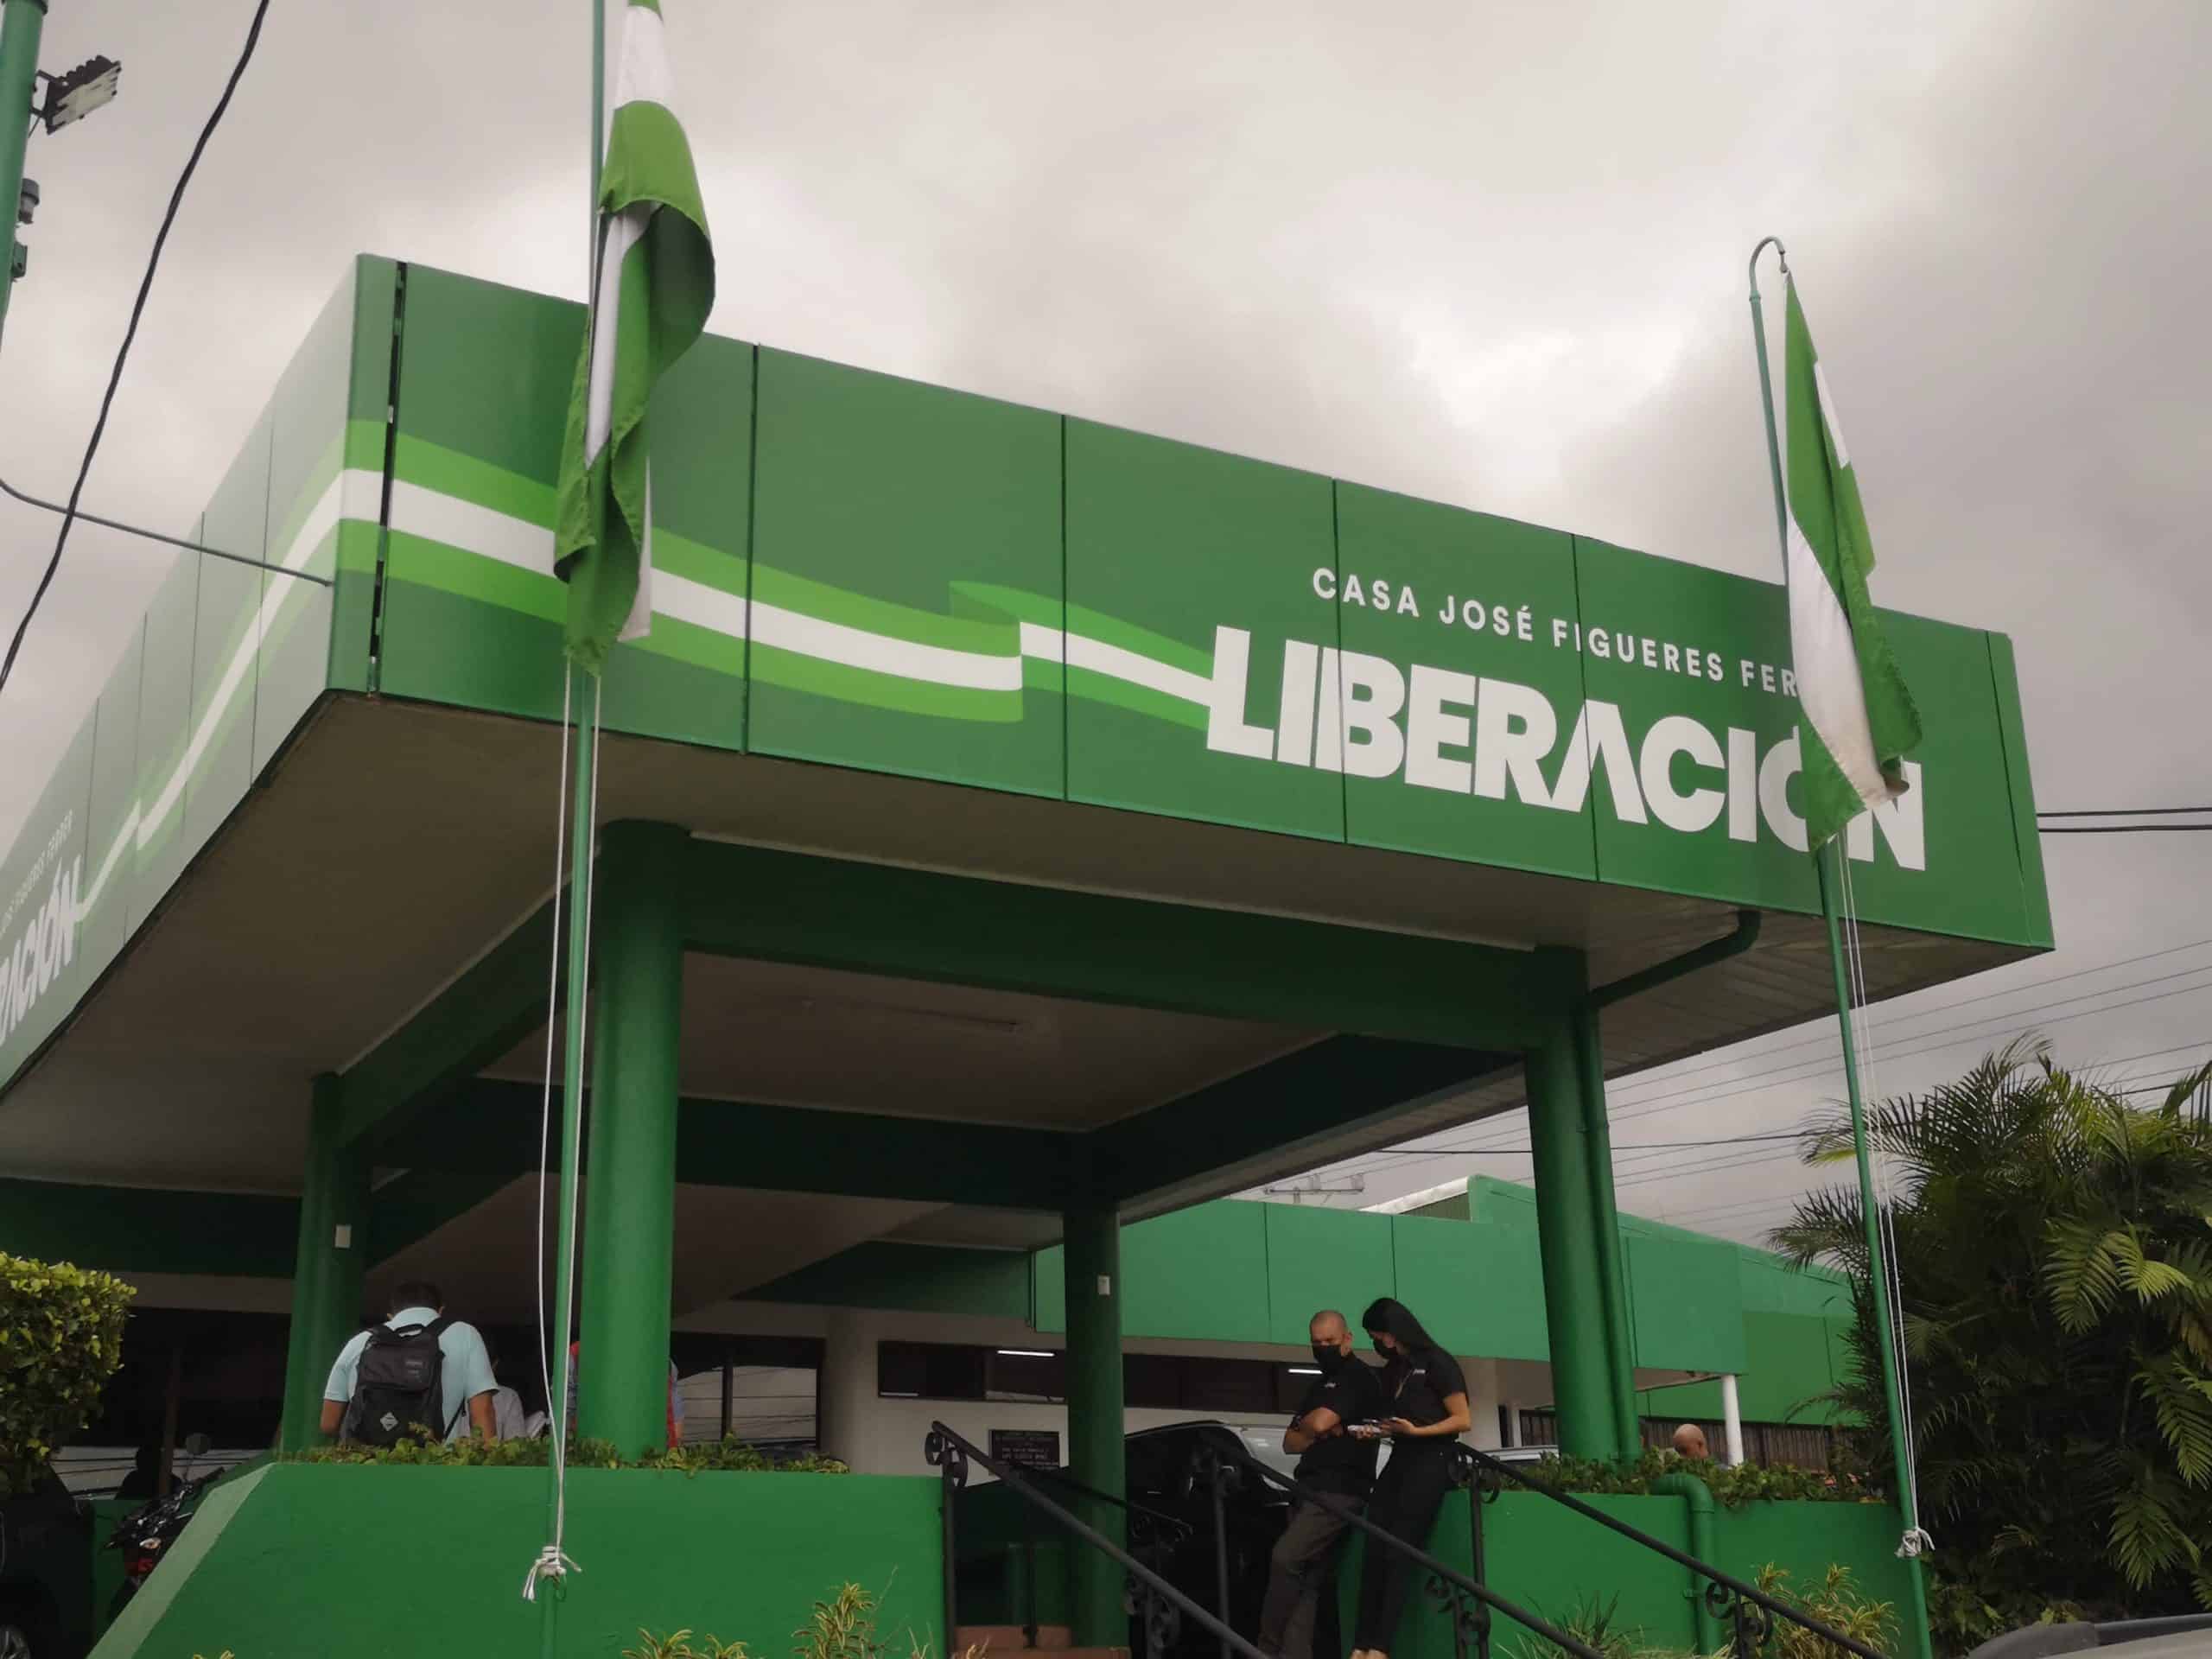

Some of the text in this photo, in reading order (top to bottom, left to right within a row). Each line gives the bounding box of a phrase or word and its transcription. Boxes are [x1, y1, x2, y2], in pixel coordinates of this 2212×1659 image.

[1312, 567, 1798, 697] CASA JOSÉ FIGUERES FER
